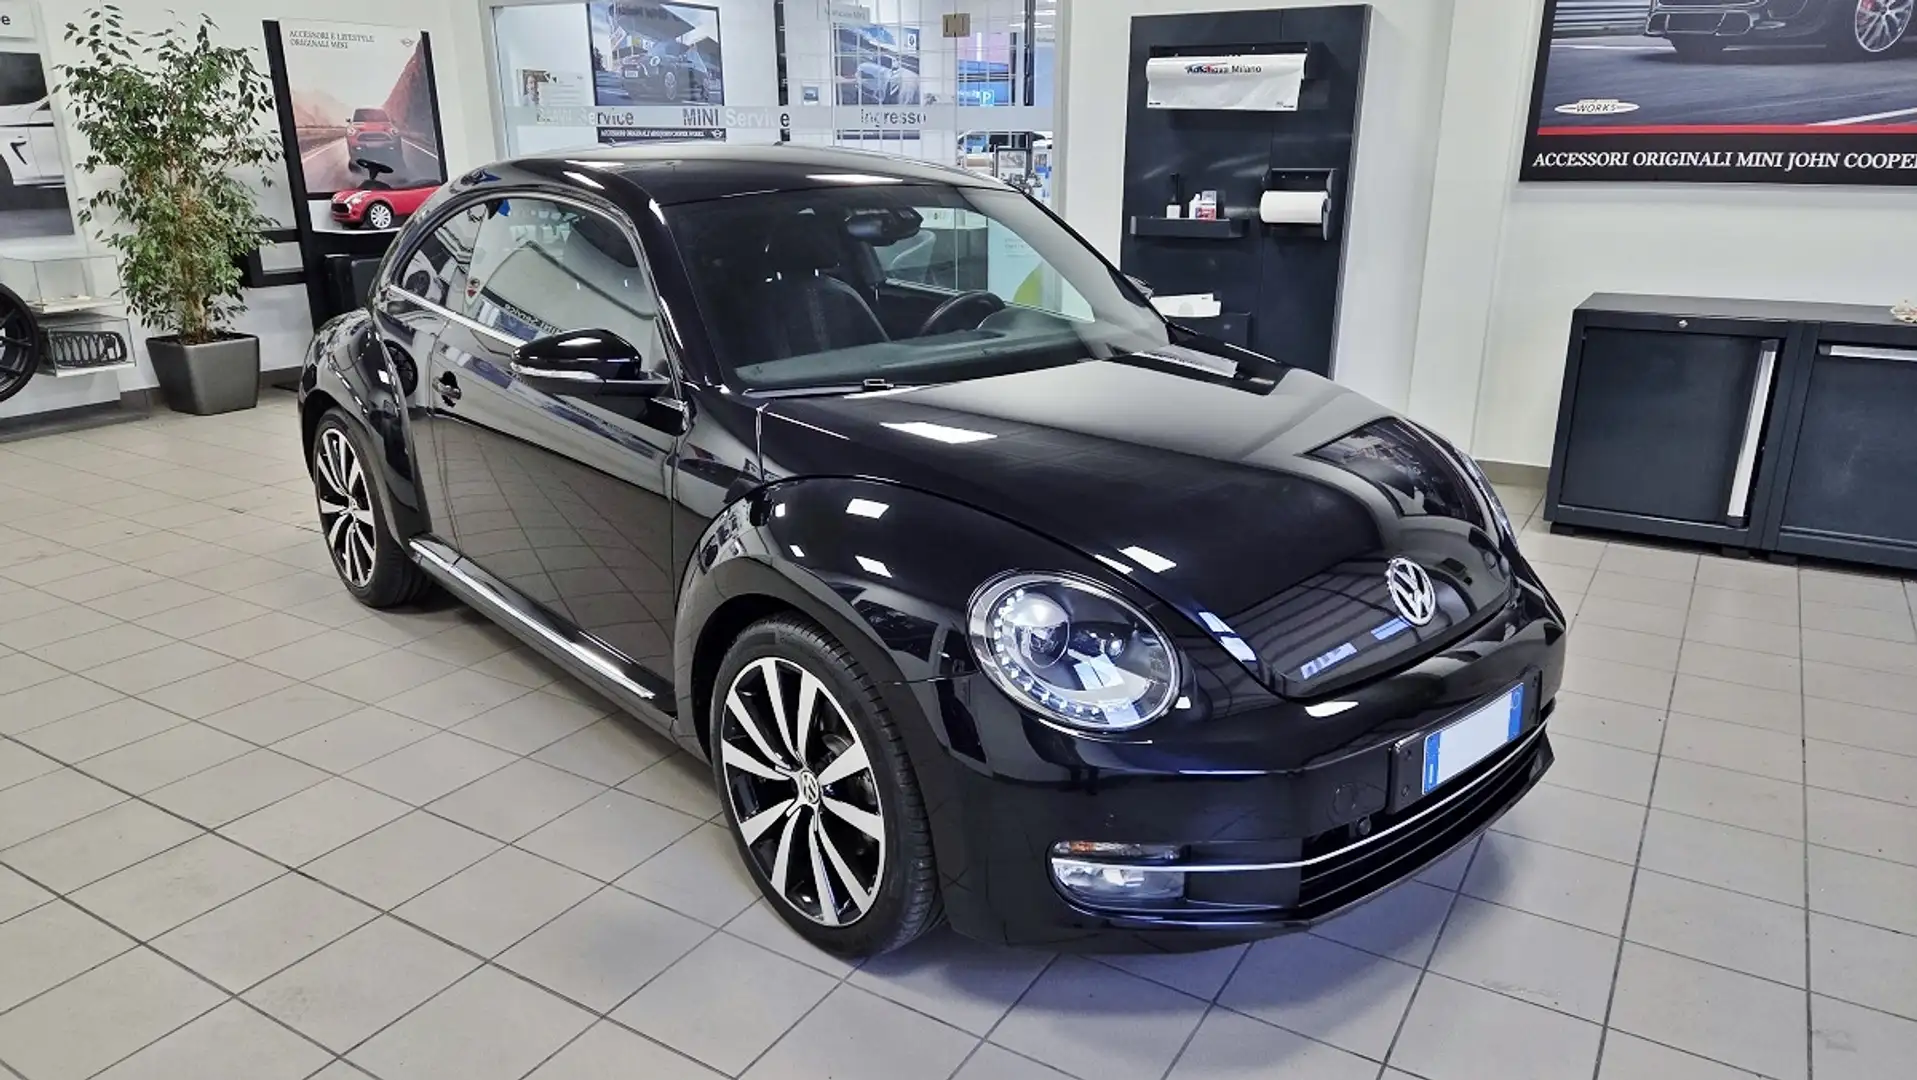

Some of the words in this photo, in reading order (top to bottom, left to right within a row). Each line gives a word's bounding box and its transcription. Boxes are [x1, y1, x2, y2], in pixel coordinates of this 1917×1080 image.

[682, 108, 719, 127] MINI
[1576, 104, 1617, 113] WORKS
[1532, 151, 1630, 167] ACCESSORI
[1632, 151, 1734, 167] ORIGINALI
[1735, 151, 1784, 168] MINI
[1784, 152, 1841, 172] JOHN
